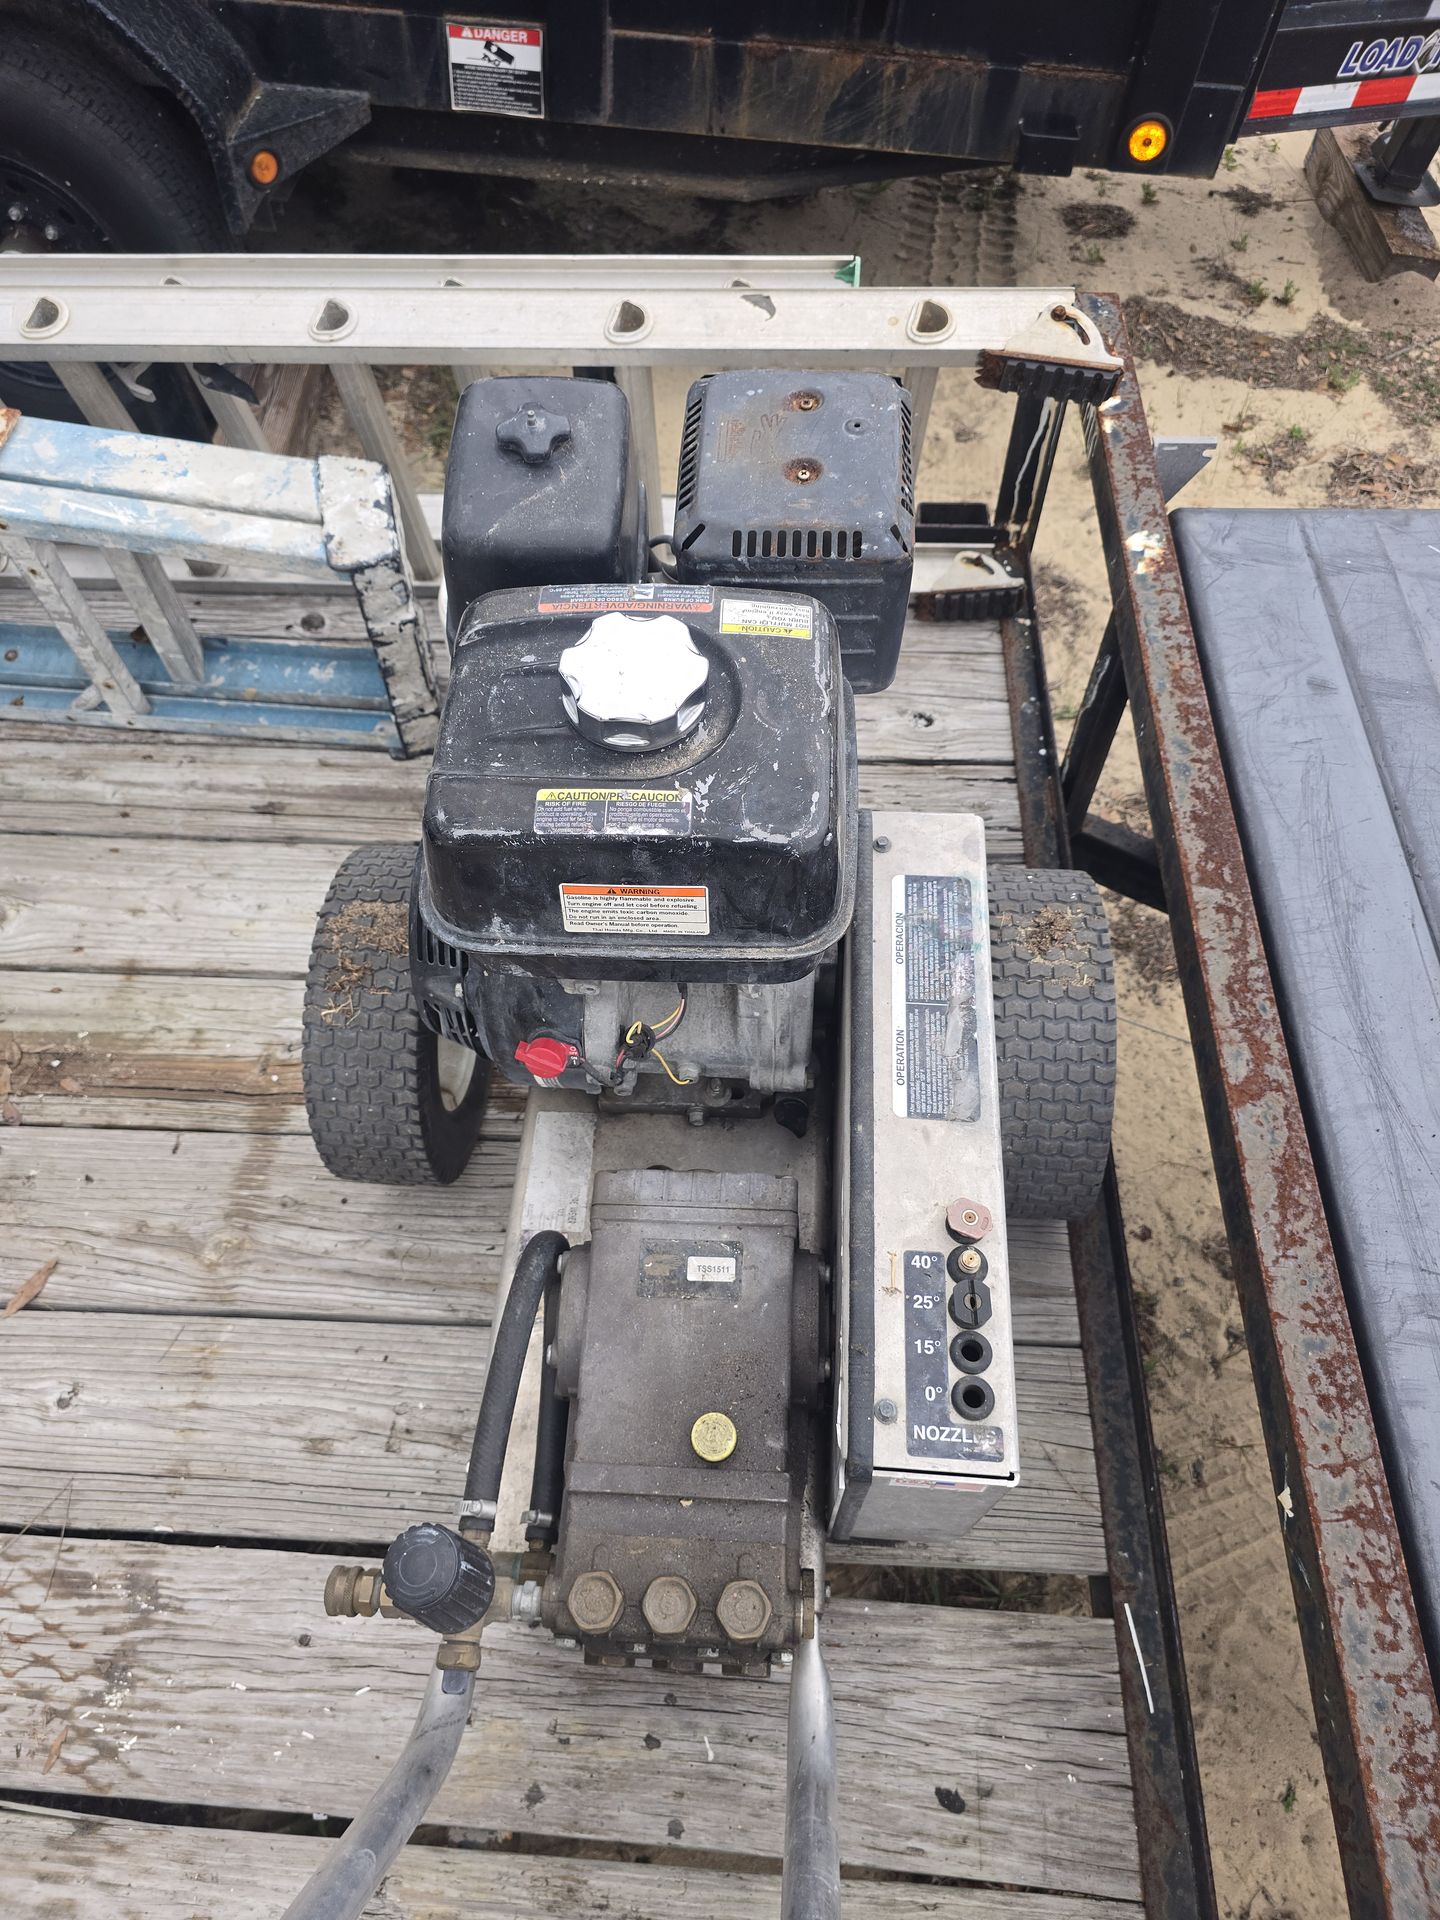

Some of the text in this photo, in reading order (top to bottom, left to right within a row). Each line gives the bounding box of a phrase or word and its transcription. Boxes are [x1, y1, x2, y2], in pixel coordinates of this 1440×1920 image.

[474, 28, 528, 43] DANGER
[1336, 35, 1425, 77] LOAD
[557, 792, 682, 801] CAUTION/PRECAUCION
[895, 912, 904, 964] OPERACION
[896, 1029, 905, 1086] OPERATION
[911, 1256, 938, 1269] 40°
[913, 1295, 940, 1309] 25°
[914, 1340, 942, 1354] 15°
[925, 1386, 943, 1401] 0°
